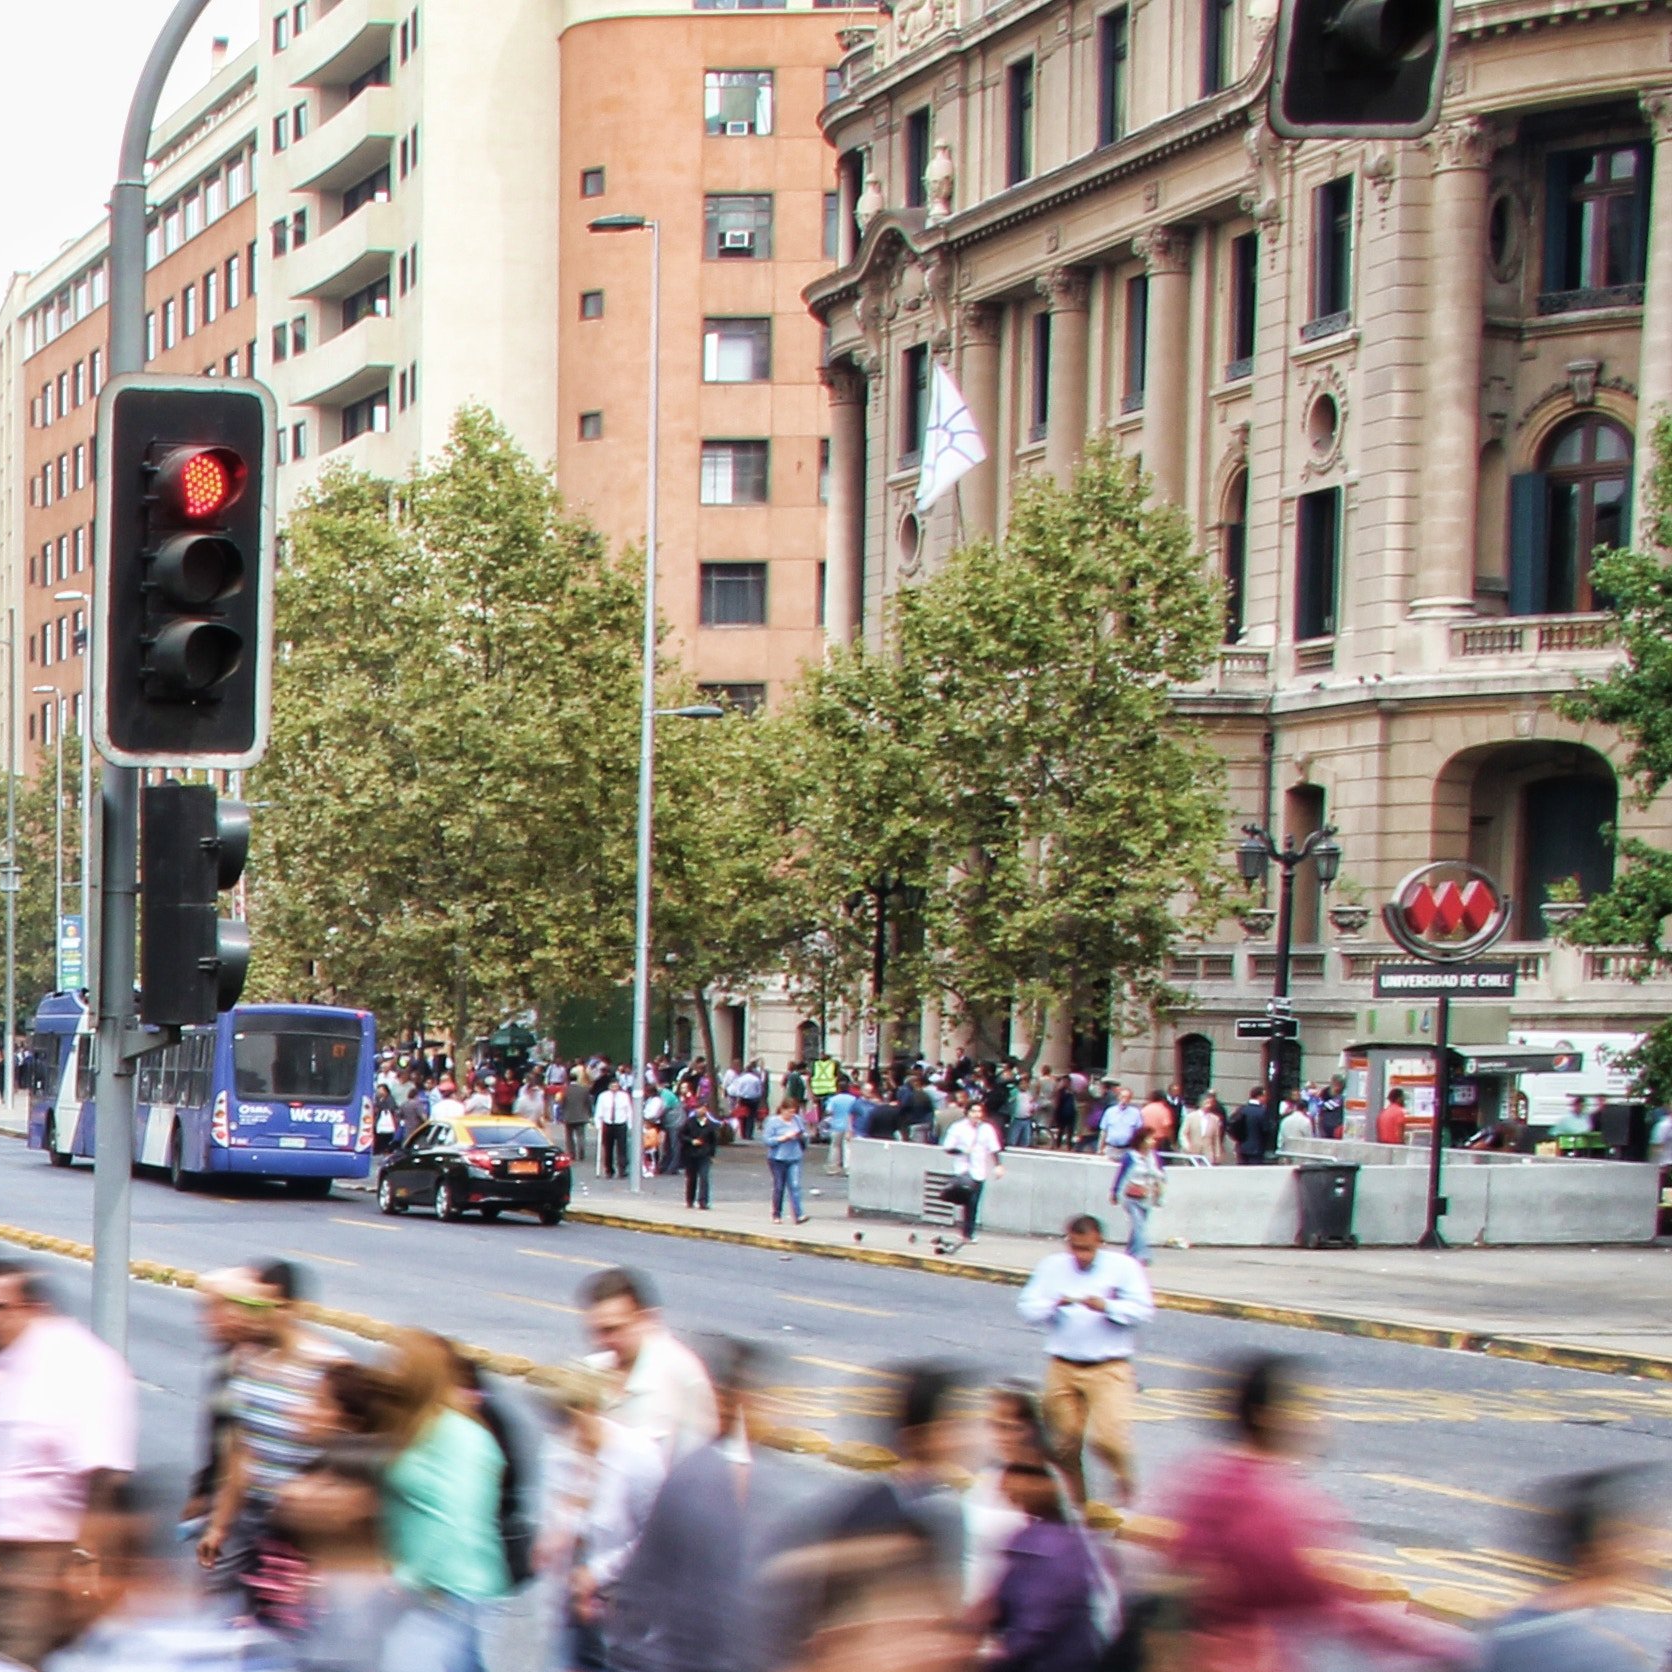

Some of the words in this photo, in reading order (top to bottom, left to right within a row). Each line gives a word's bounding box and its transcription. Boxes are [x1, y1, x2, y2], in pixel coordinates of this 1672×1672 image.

[1380, 974, 1459, 988] UNIVERSIDAD
[1460, 974, 1477, 988] DE
[1478, 974, 1511, 988] CHILE
[289, 1107, 313, 1123] WC
